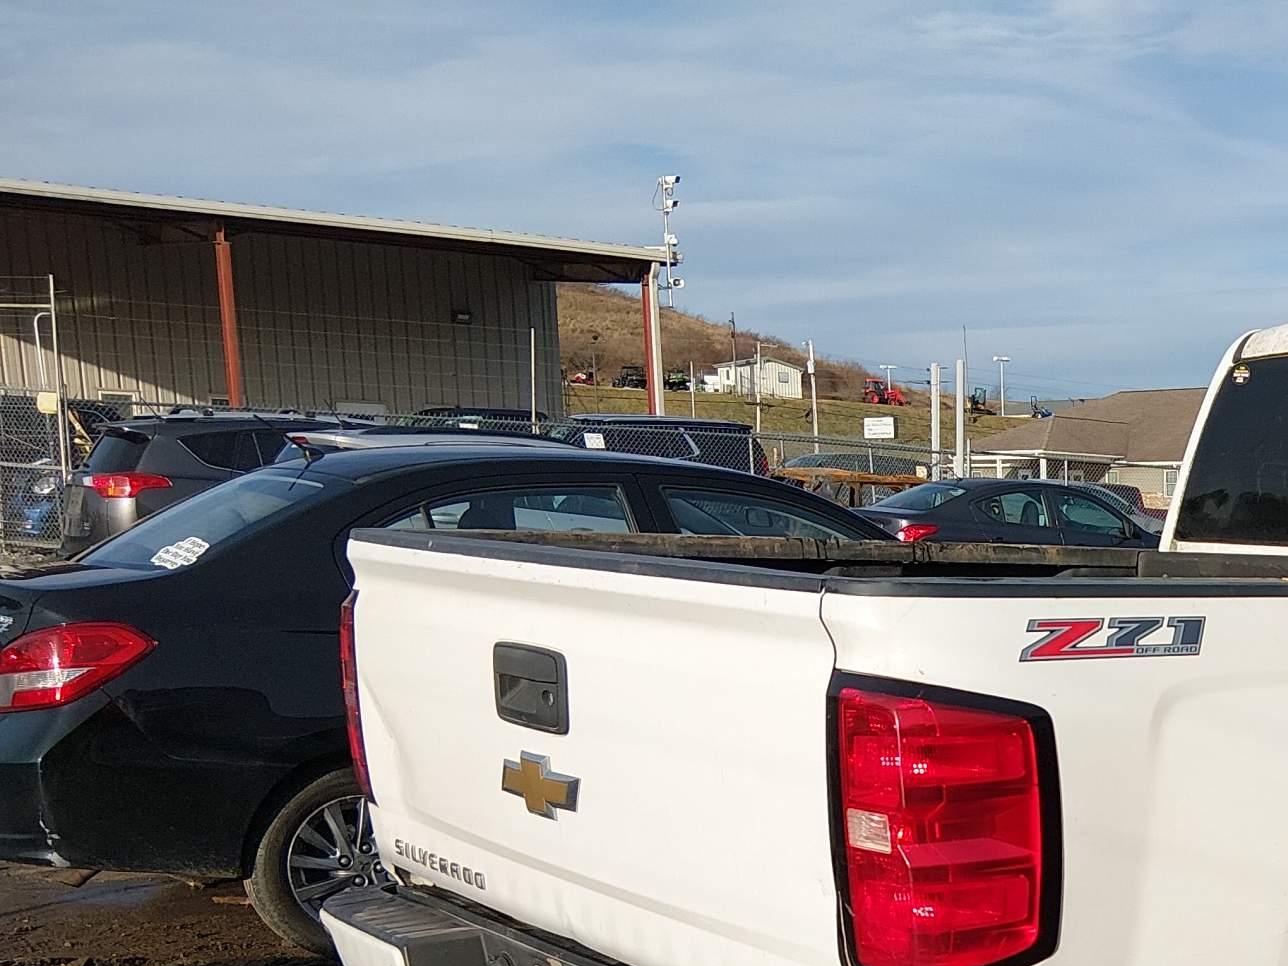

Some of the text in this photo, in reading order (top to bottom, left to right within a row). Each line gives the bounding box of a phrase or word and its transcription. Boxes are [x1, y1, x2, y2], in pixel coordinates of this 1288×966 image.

[1019, 616, 1206, 662] Z71
[1136, 646, 1198, 655] OFF ROAD
[394, 838, 487, 891] SILVERADO
